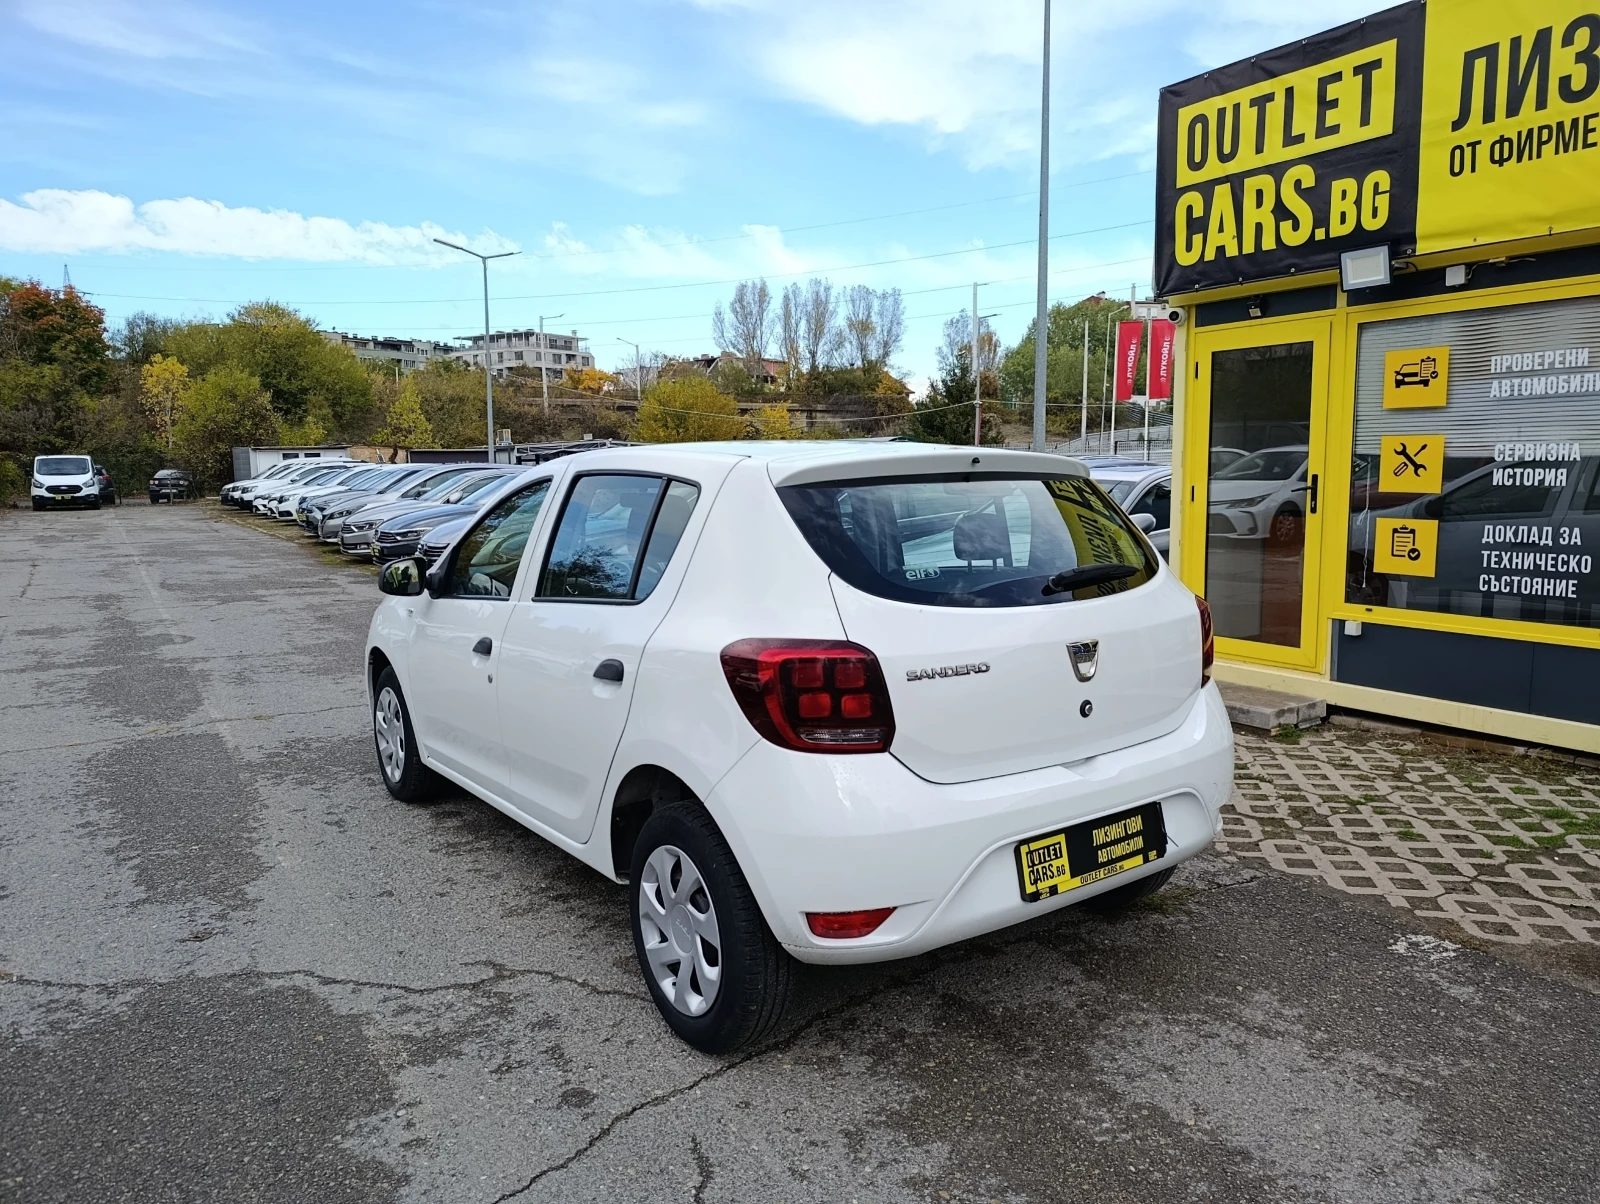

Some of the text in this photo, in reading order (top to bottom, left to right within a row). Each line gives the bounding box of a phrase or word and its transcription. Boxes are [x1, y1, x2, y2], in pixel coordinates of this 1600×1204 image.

[1451, 13, 1600, 133] ЛИЗ
[1186, 58, 1383, 172] OUTLET
[1449, 112, 1600, 178] ОТ ФИРМЕ
[1174, 164, 1392, 267] CARS.BG
[1490, 347, 1589, 373] ПРОВЕРЕНИ
[1494, 443, 1581, 462] СЕРВИЗНА
[1492, 468, 1567, 487] ИСТОРИЯ
[1481, 525, 1582, 546] ДОКЛАД ЗА
[1481, 550, 1592, 574] ТЕХНИЧЕСКО
[1479, 574, 1578, 598] СЪСТОЯНИЕ
[906, 662, 990, 682] SANDERO
[1092, 814, 1143, 847] ЛИЗИНГОВИ
[1097, 835, 1144, 864] АВТОМОБИЛИ
[1028, 863, 1066, 886] CARS.BG
[1079, 870, 1102, 885] OUTLET
